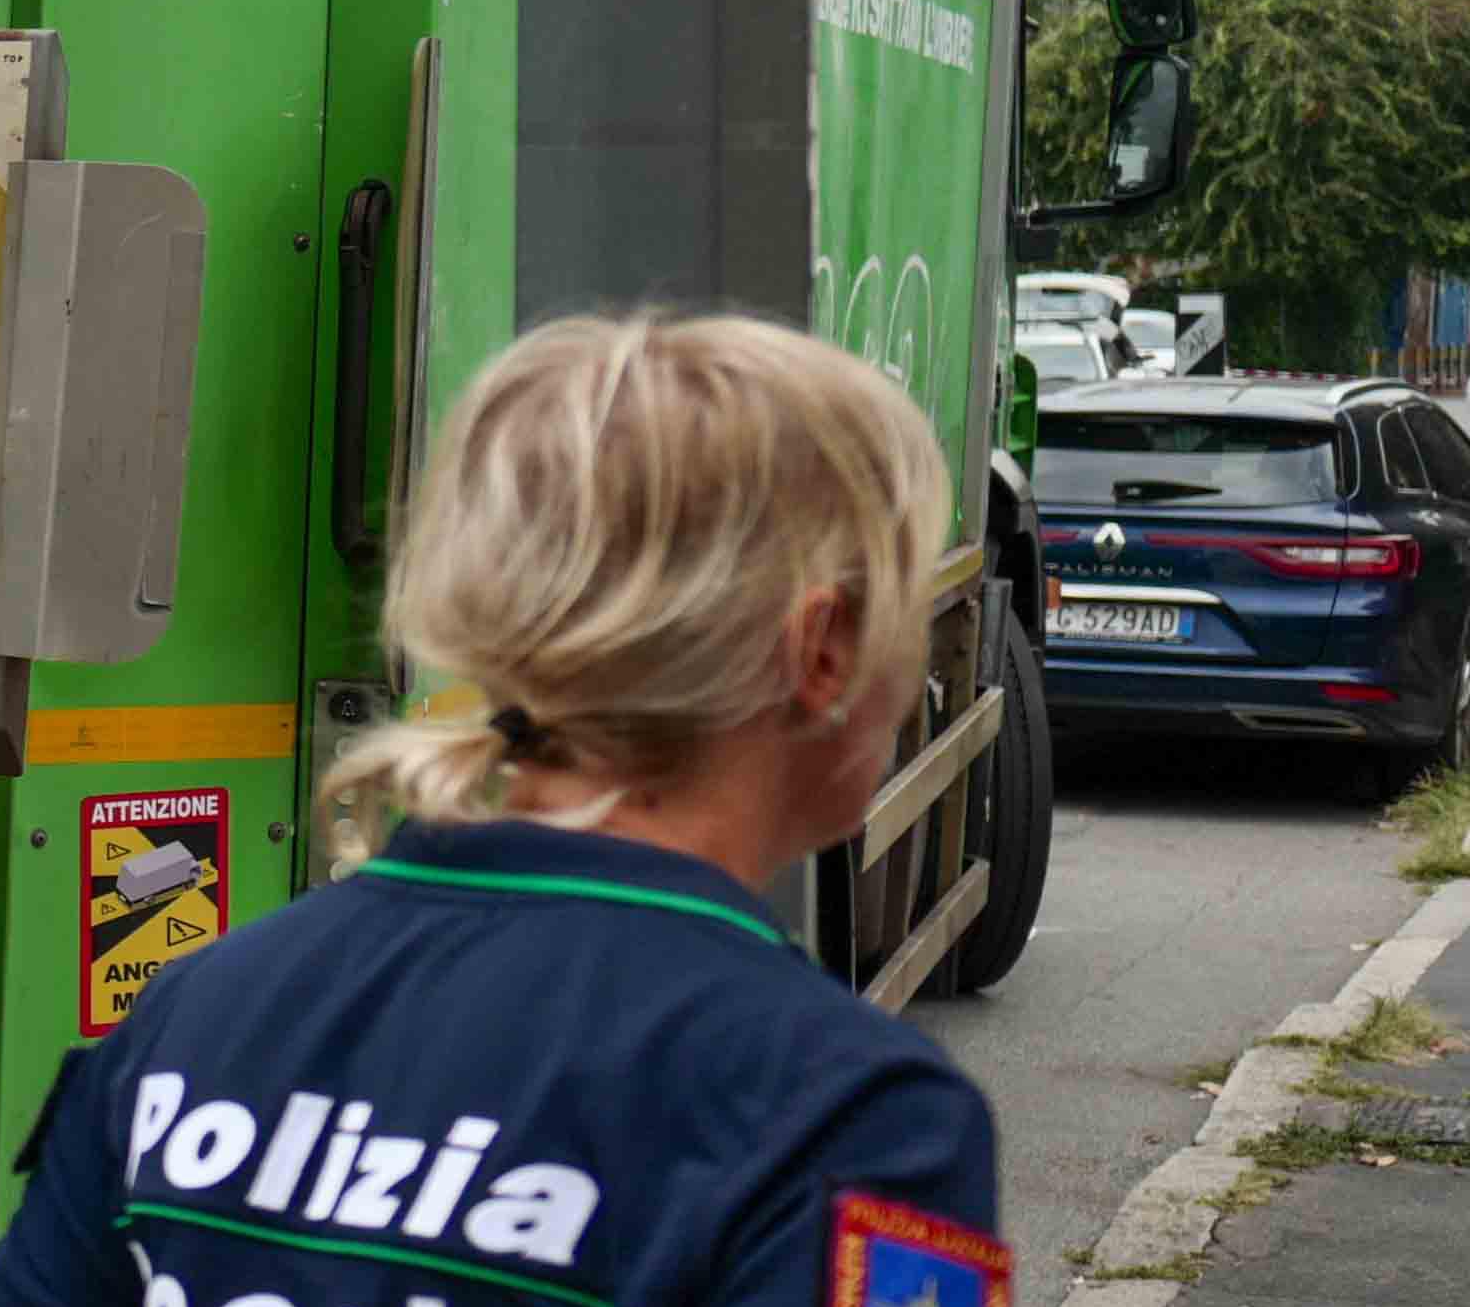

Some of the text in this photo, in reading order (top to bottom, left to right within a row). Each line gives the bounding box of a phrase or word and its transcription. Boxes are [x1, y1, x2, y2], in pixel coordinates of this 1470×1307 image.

[1084, 605, 1176, 635] 529AD
[91, 794, 219, 824] ATTENZIONE
[124, 1071, 600, 1267] Polizia
